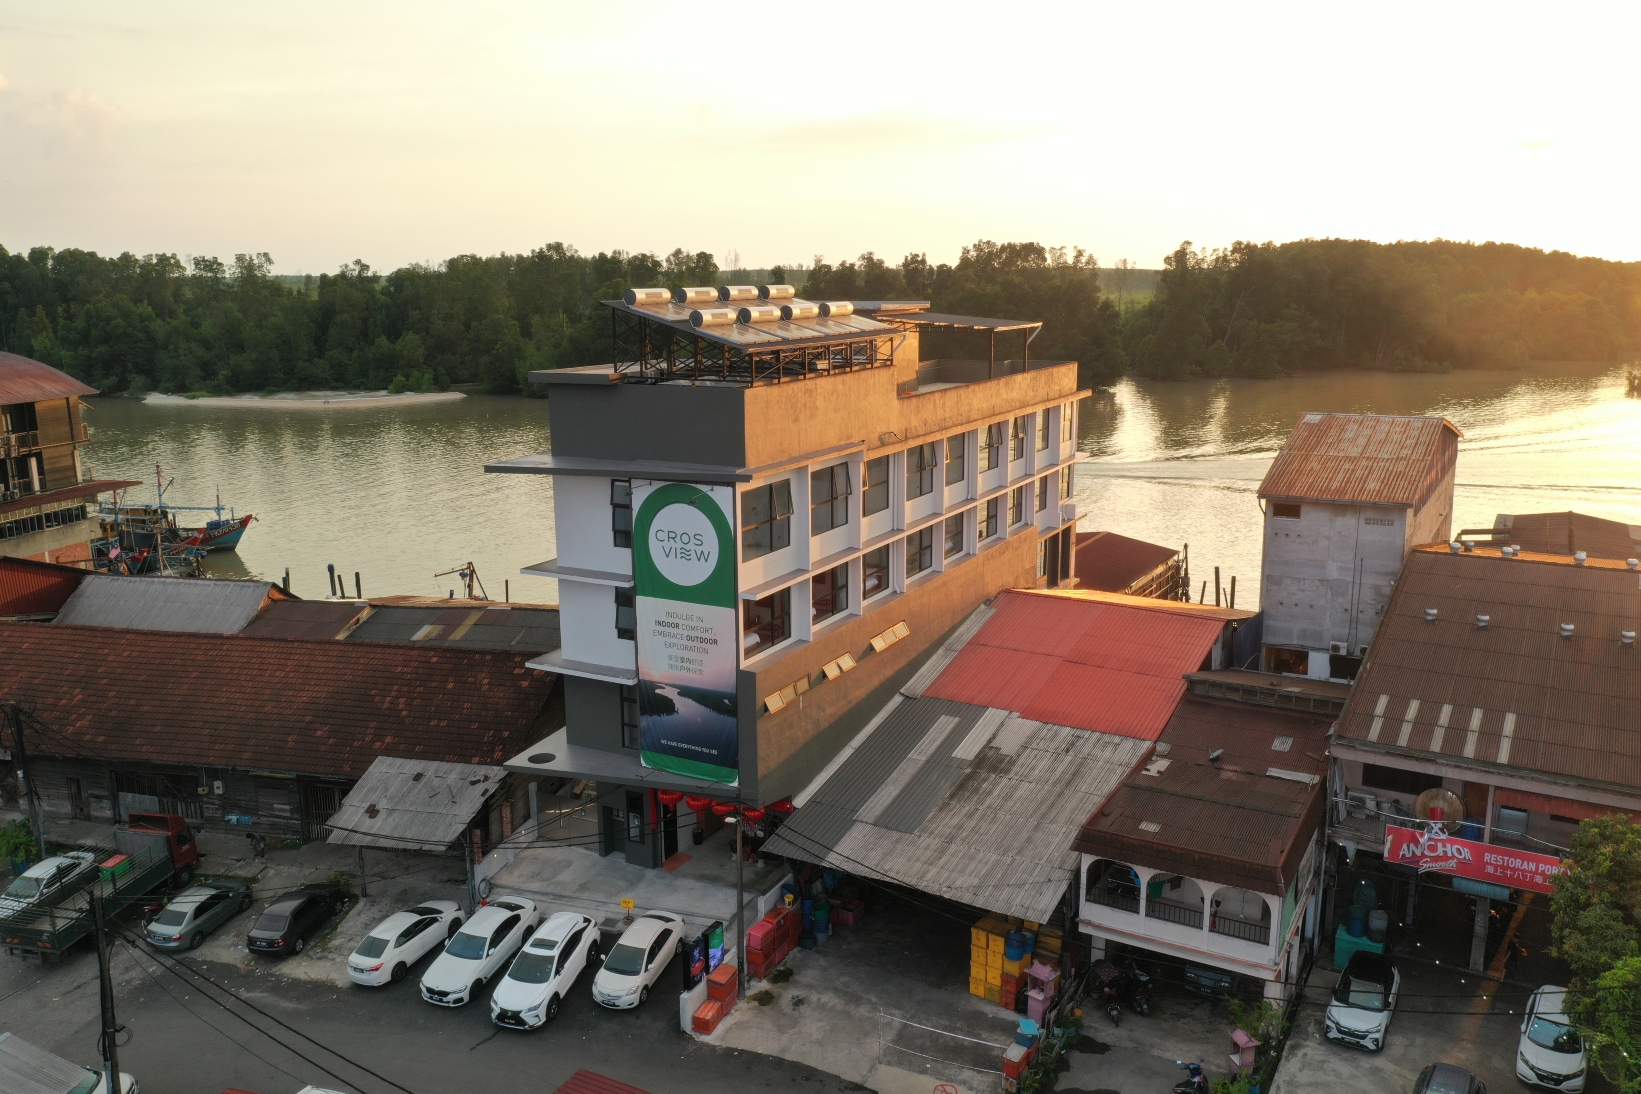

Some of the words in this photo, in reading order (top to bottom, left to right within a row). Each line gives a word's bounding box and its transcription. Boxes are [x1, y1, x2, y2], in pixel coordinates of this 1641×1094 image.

[655, 529, 704, 546] CROS
[655, 620, 680, 630] INDOOR
[665, 611, 694, 622] INDULGE
[696, 615, 704, 623] IN
[653, 629, 685, 641] EMBRACE
[686, 635, 718, 646] OUTDOOR
[664, 641, 709, 655] EXPLORATION
[1399, 841, 1473, 861] ANCHOR
[1418, 857, 1458, 872] Smooth
[1484, 852, 1536, 872] RESTORAN
